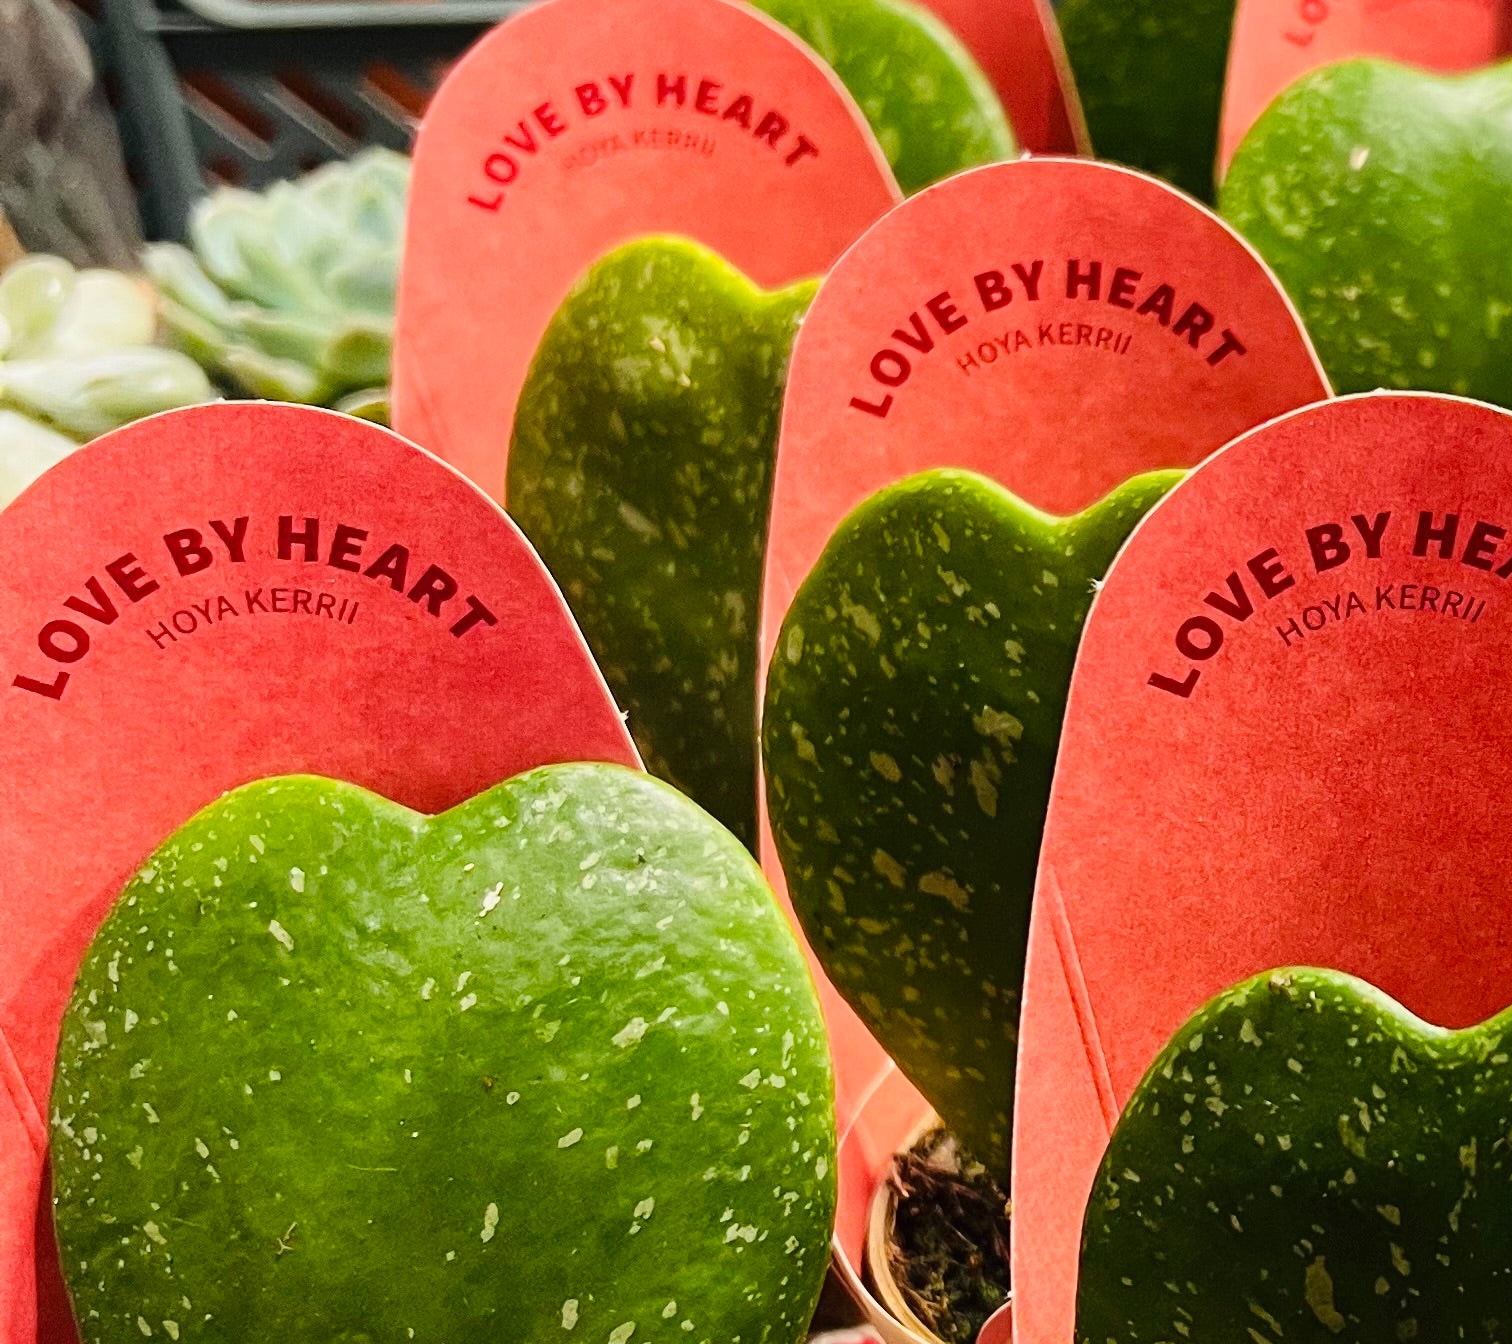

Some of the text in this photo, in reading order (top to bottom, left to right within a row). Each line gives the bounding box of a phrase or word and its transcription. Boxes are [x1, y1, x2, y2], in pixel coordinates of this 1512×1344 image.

[467, 73, 820, 214] LOVE BY HEART
[849, 258, 1247, 418] LOVE BY HEART
[956, 321, 1133, 377] HOYA KERRII
[12, 515, 499, 702] LOVE BY HEART
[145, 587, 360, 650] HOYA KERRII
[1147, 547, 1296, 699] LOVE
[1305, 511, 1391, 575] BY
[1276, 584, 1487, 647] HOYA KERRII
